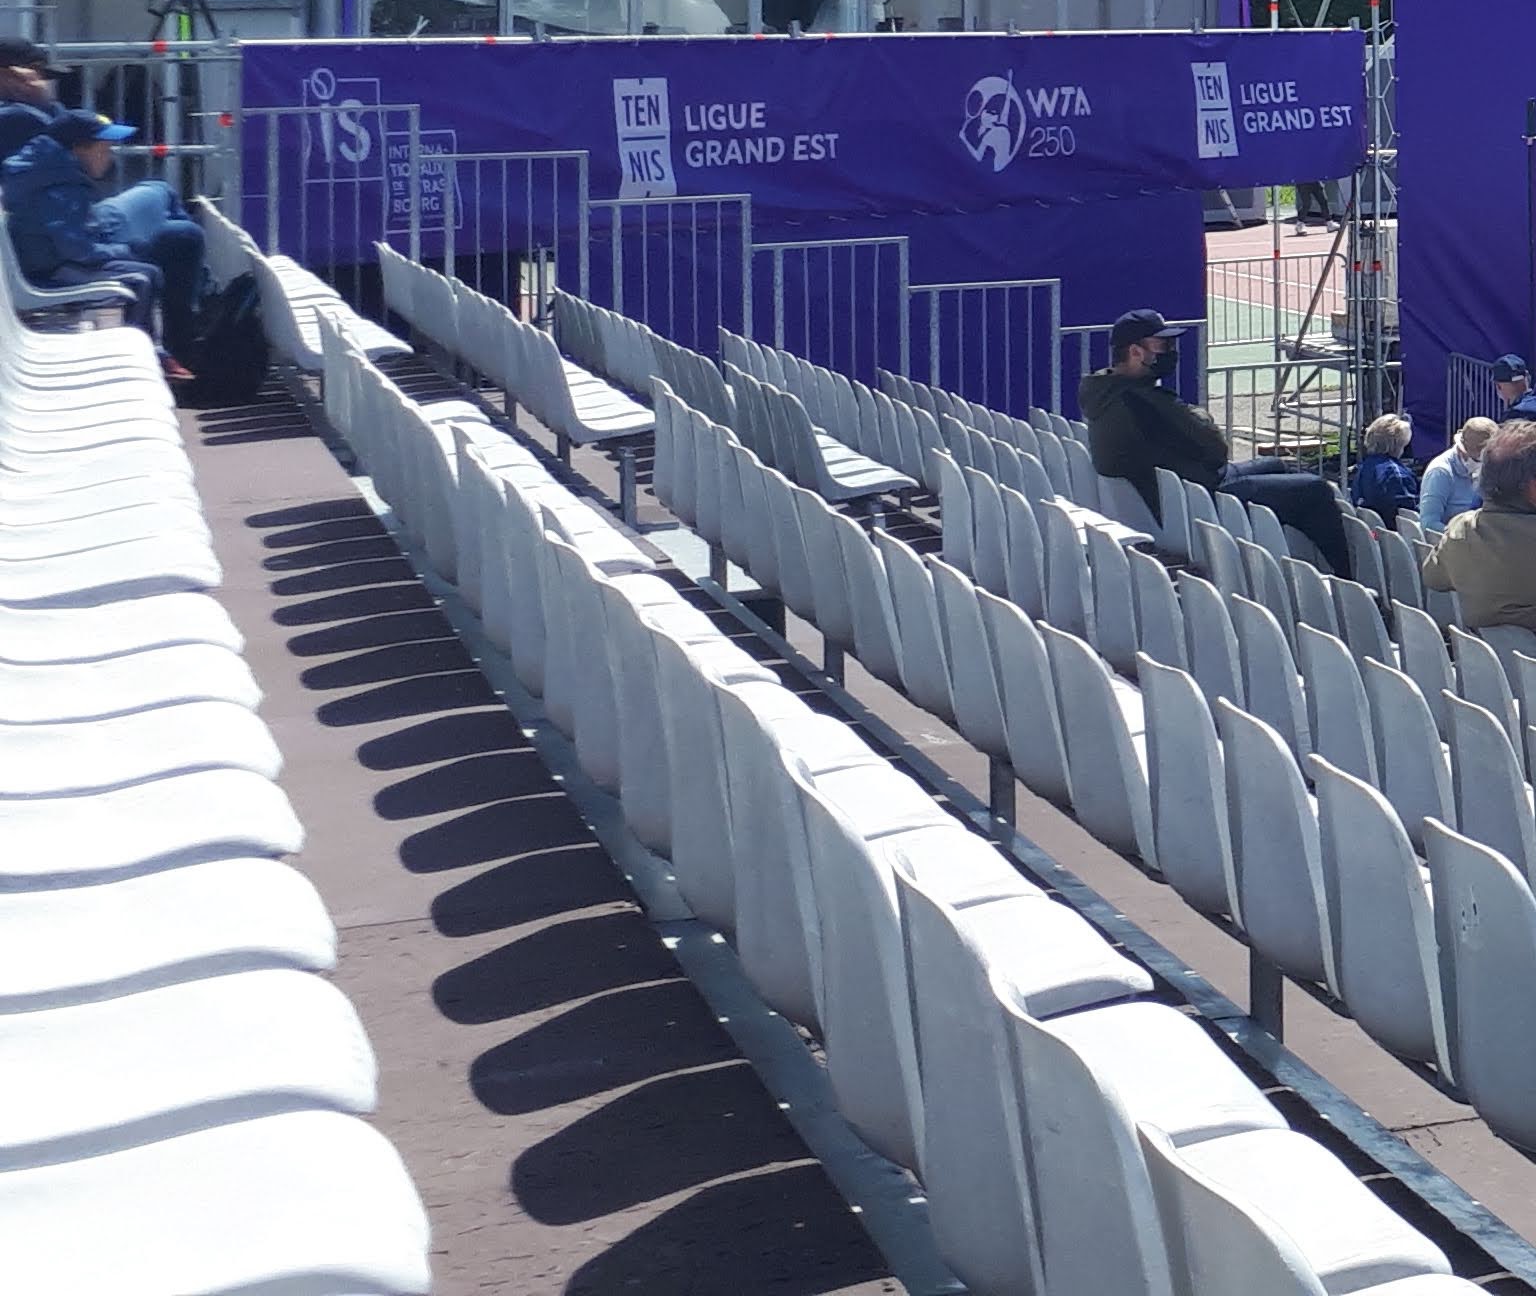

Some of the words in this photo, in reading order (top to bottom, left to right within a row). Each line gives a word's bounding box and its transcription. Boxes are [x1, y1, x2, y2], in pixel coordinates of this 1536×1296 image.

[1026, 86, 1092, 120] WTA
[1198, 72, 1224, 102] TEN
[1240, 80, 1297, 106] LIGUE
[621, 93, 660, 130] TEN
[684, 102, 766, 132] LIGUE
[1242, 108, 1315, 135] GRAND
[1320, 105, 1353, 128] EST
[1027, 125, 1077, 159] 250
[1205, 117, 1231, 147] NIS
[627, 148, 665, 184] NIS
[685, 137, 787, 168] GRAND
[793, 133, 840, 163] EST
